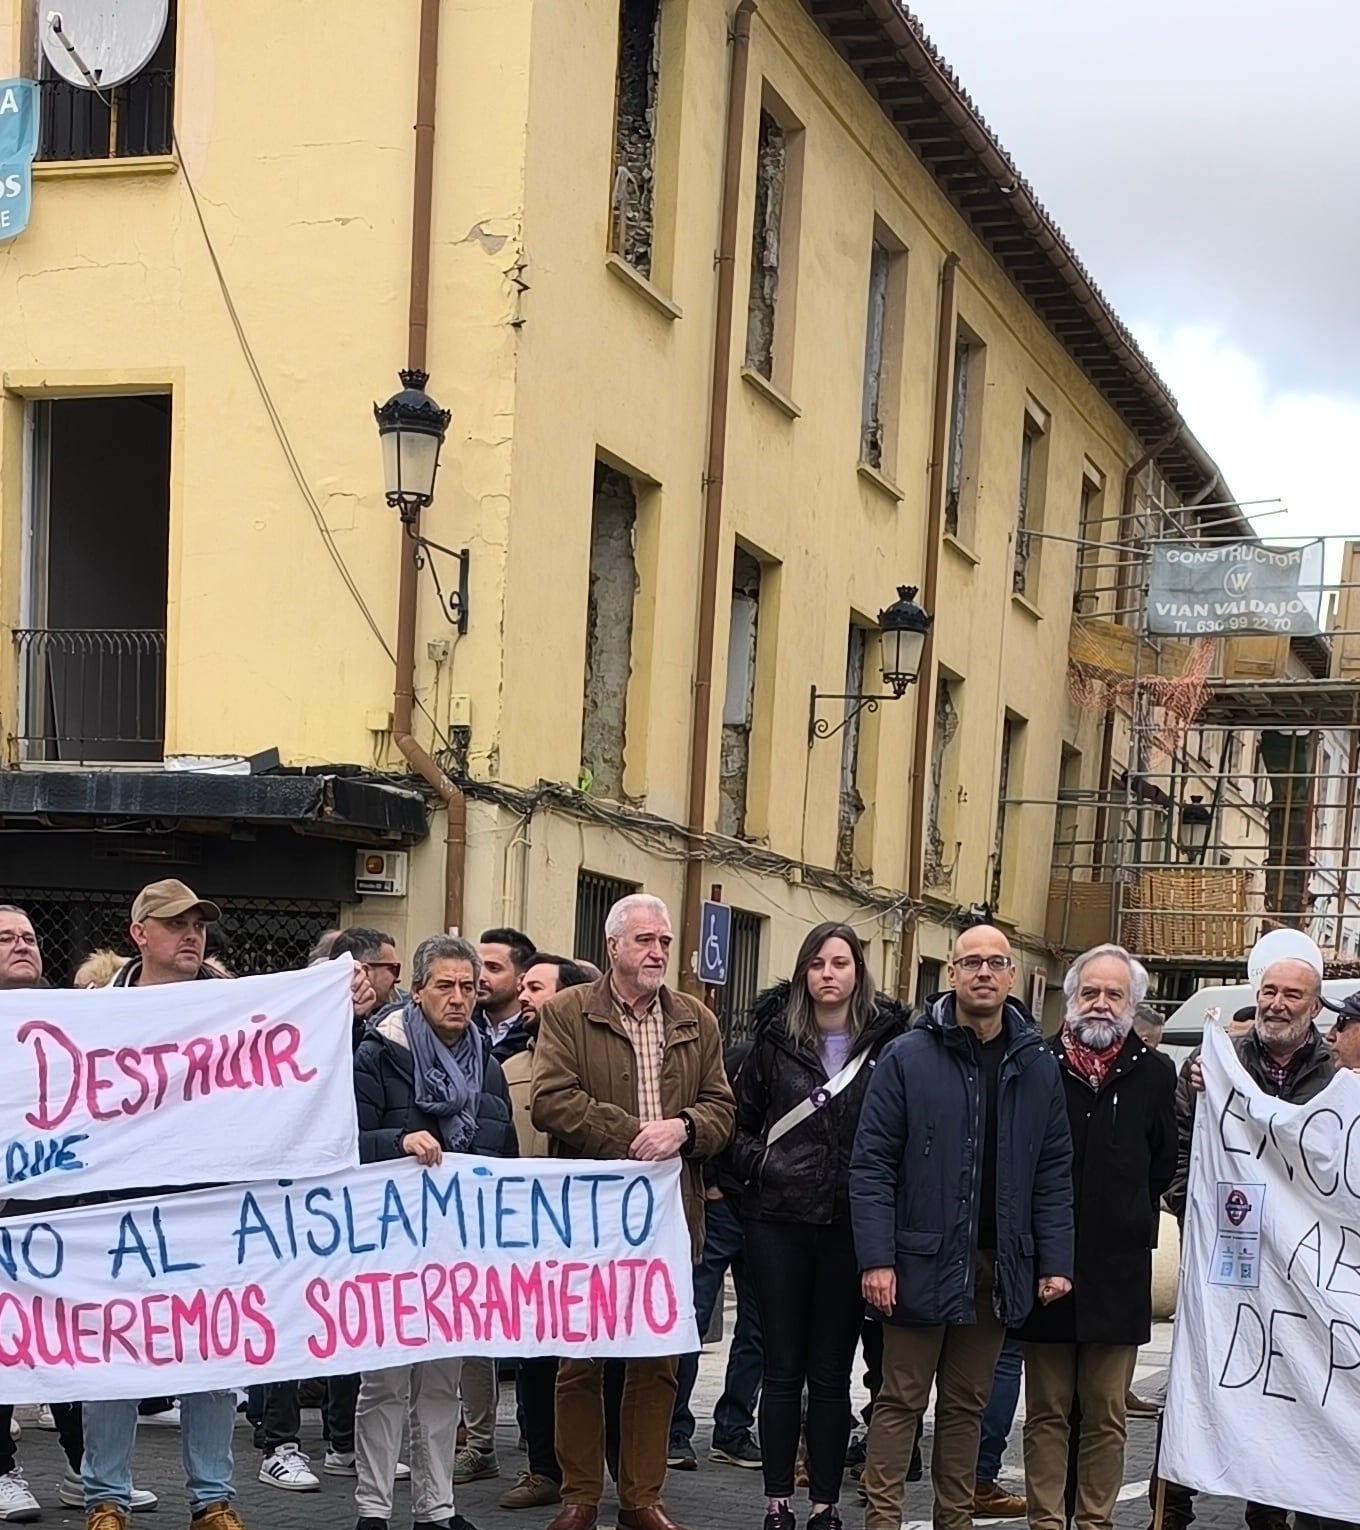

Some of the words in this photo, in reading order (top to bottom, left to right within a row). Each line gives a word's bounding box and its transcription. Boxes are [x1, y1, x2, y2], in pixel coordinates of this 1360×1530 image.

[1166, 544, 1312, 567] CONSTRUCTORA
[1155, 602, 1209, 617] VIAN
[1197, 620, 1225, 633] 630
[1229, 617, 1248, 630] 99
[1252, 617, 1268, 630] 22
[1273, 618, 1292, 631] 70
[17, 1013, 317, 1132] DESTRUIR
[109, 1206, 204, 1278] AL
[237, 1165, 654, 1265] AISLAMIENTO
[307, 1257, 678, 1359] SOTERRAMIENTO
[1219, 1302, 1306, 1402] DE
